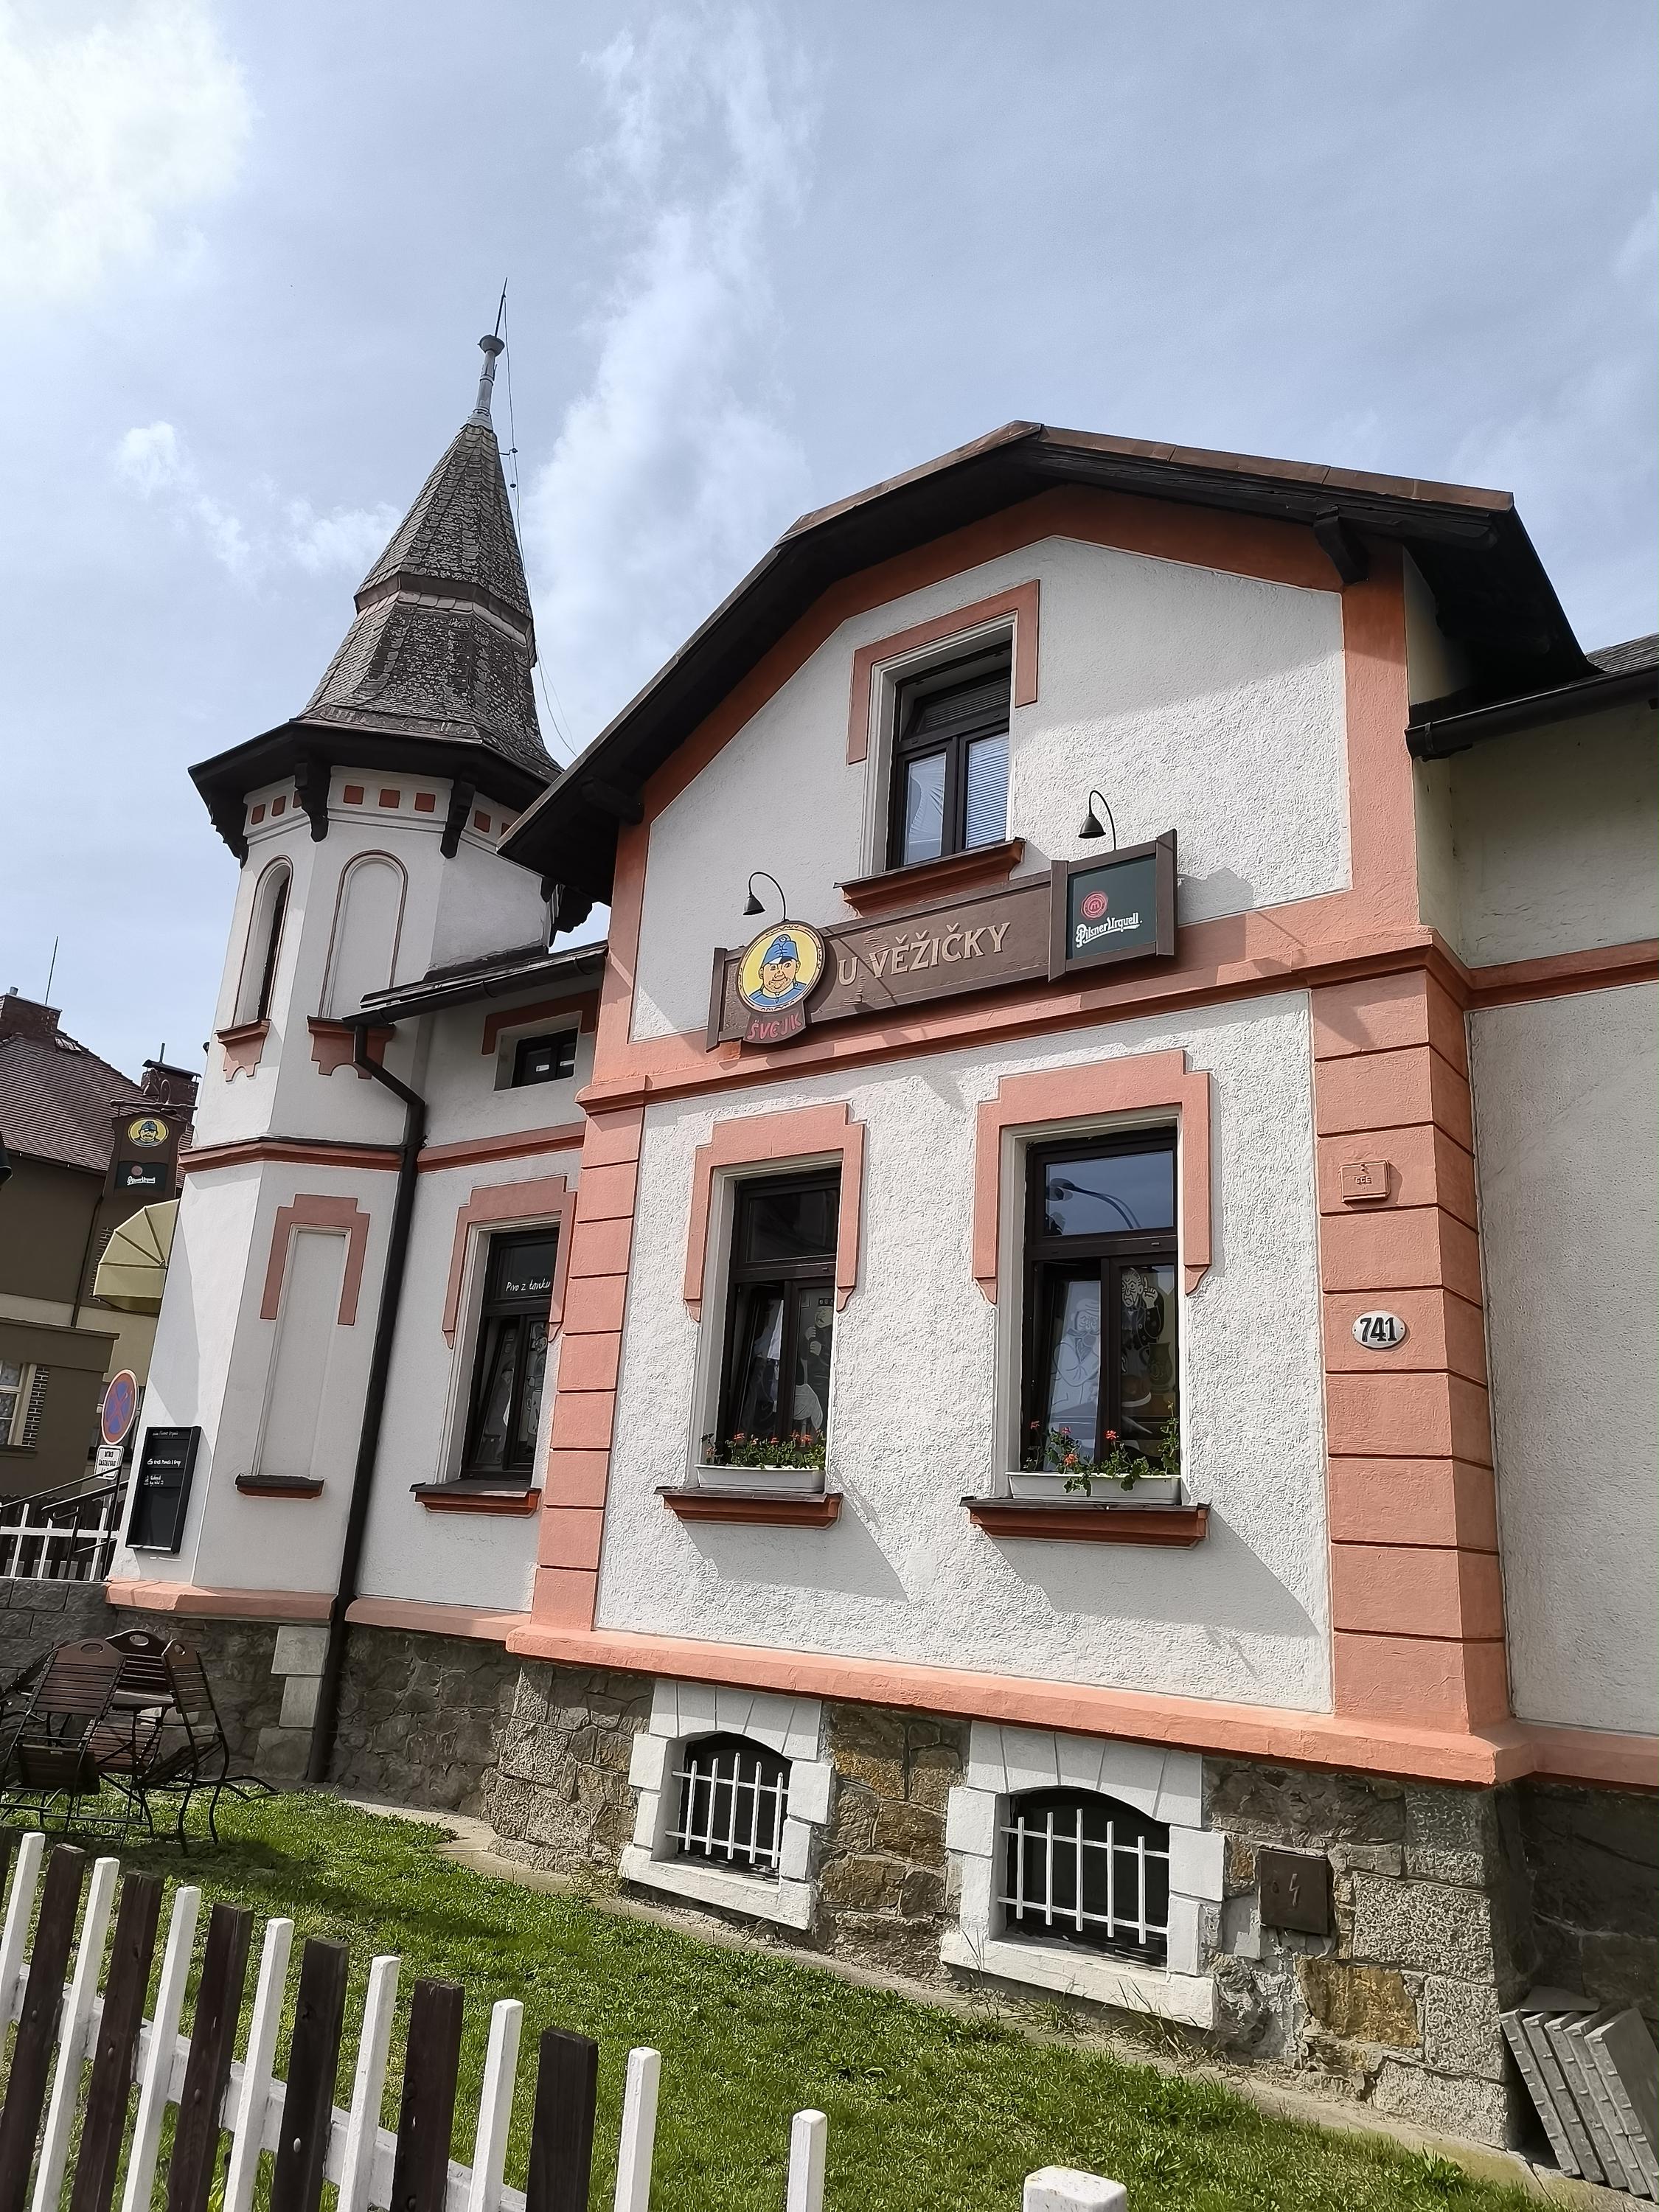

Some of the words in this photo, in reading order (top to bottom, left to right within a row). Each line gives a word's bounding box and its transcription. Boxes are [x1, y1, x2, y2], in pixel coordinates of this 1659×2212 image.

[1075, 923, 1108, 948] Pilsner
[838, 957, 858, 986] U
[869, 922, 1011, 979] VĚŽIČKY
[746, 1012, 802, 1040] ŠVEJK
[505, 1281, 520, 1292] Pivo
[529, 1278, 551, 1290] tanku
[1360, 1317, 1397, 1342] 741
